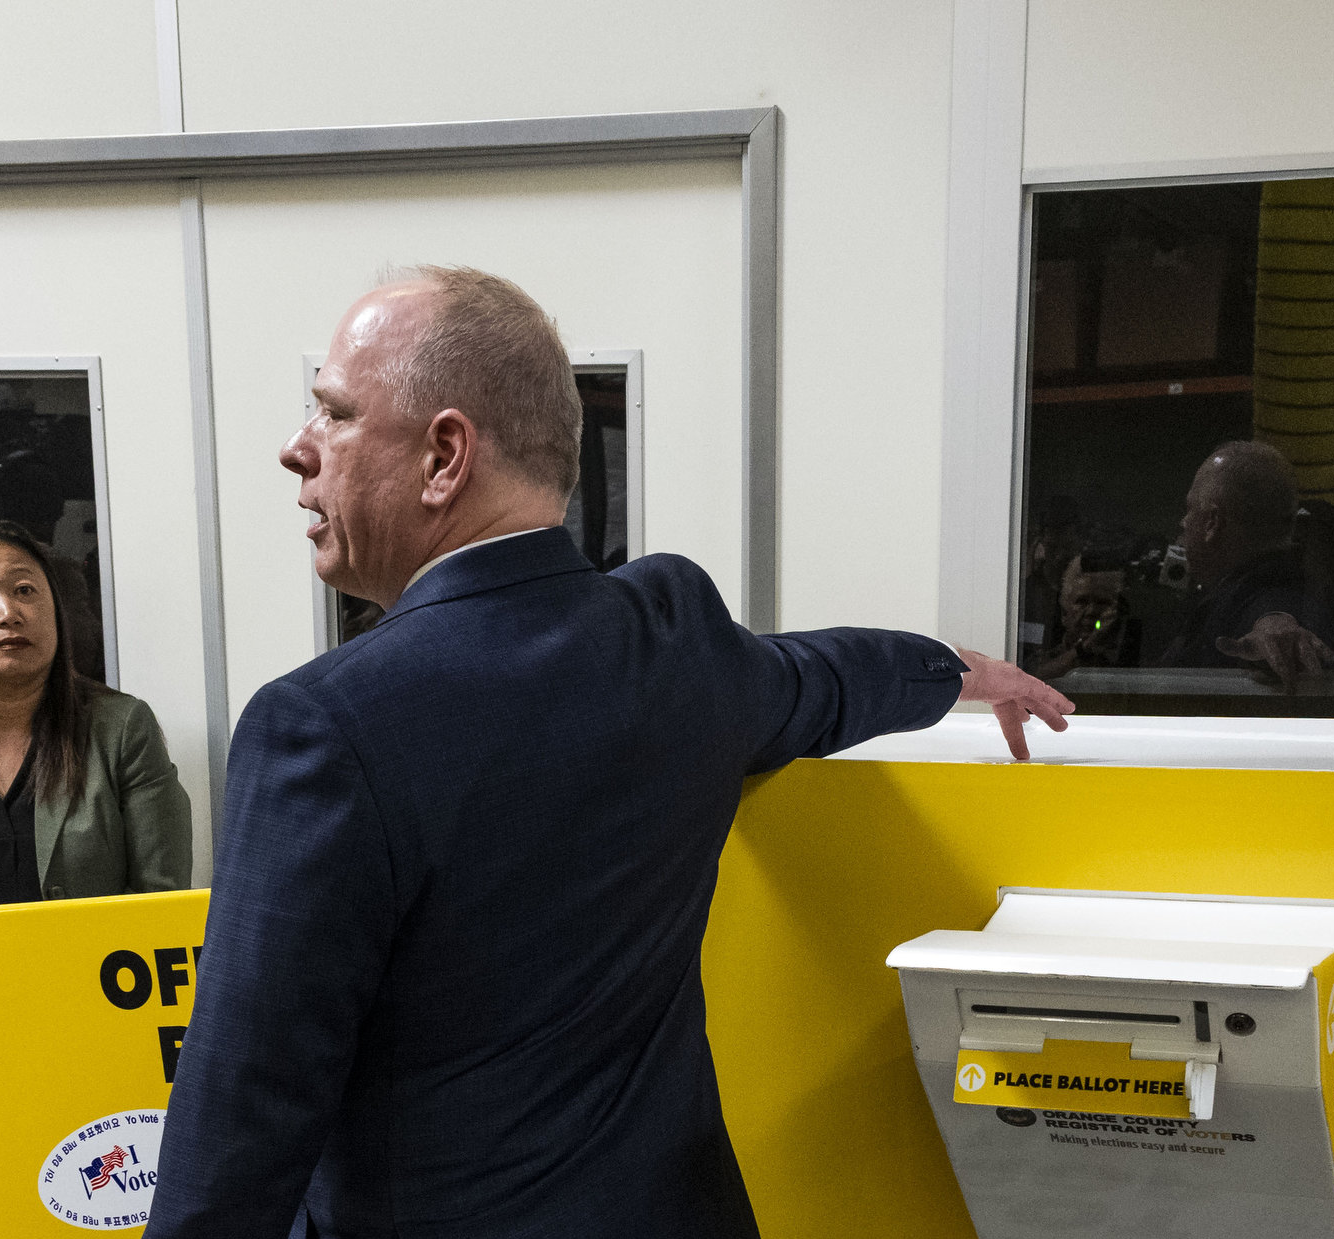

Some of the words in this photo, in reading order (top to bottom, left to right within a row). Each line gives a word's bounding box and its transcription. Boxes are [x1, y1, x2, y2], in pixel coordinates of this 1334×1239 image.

[994, 1072, 1052, 1089] PLACE
[1058, 1076, 1130, 1092] BALLOT
[1133, 1080, 1184, 1096] HERE
[125, 1115, 137, 1125] Yo
[138, 1114, 159, 1124] Voté
[1042, 1110, 1117, 1124] ORANGE
[1123, 1114, 1199, 1129] COUNTY
[1045, 1119, 1148, 1135] REGISTRAR
[1154, 1127, 1178, 1136] OF
[1183, 1129, 1256, 1142] VOTERS
[127, 1144, 141, 1165] I
[1050, 1133, 1089, 1147] Making
[1090, 1137, 1138, 1149] elections
[1141, 1141, 1165, 1153] easy
[1167, 1142, 1187, 1153] and
[1189, 1145, 1225, 1156] secure
[109, 1169, 157, 1194] Vote
